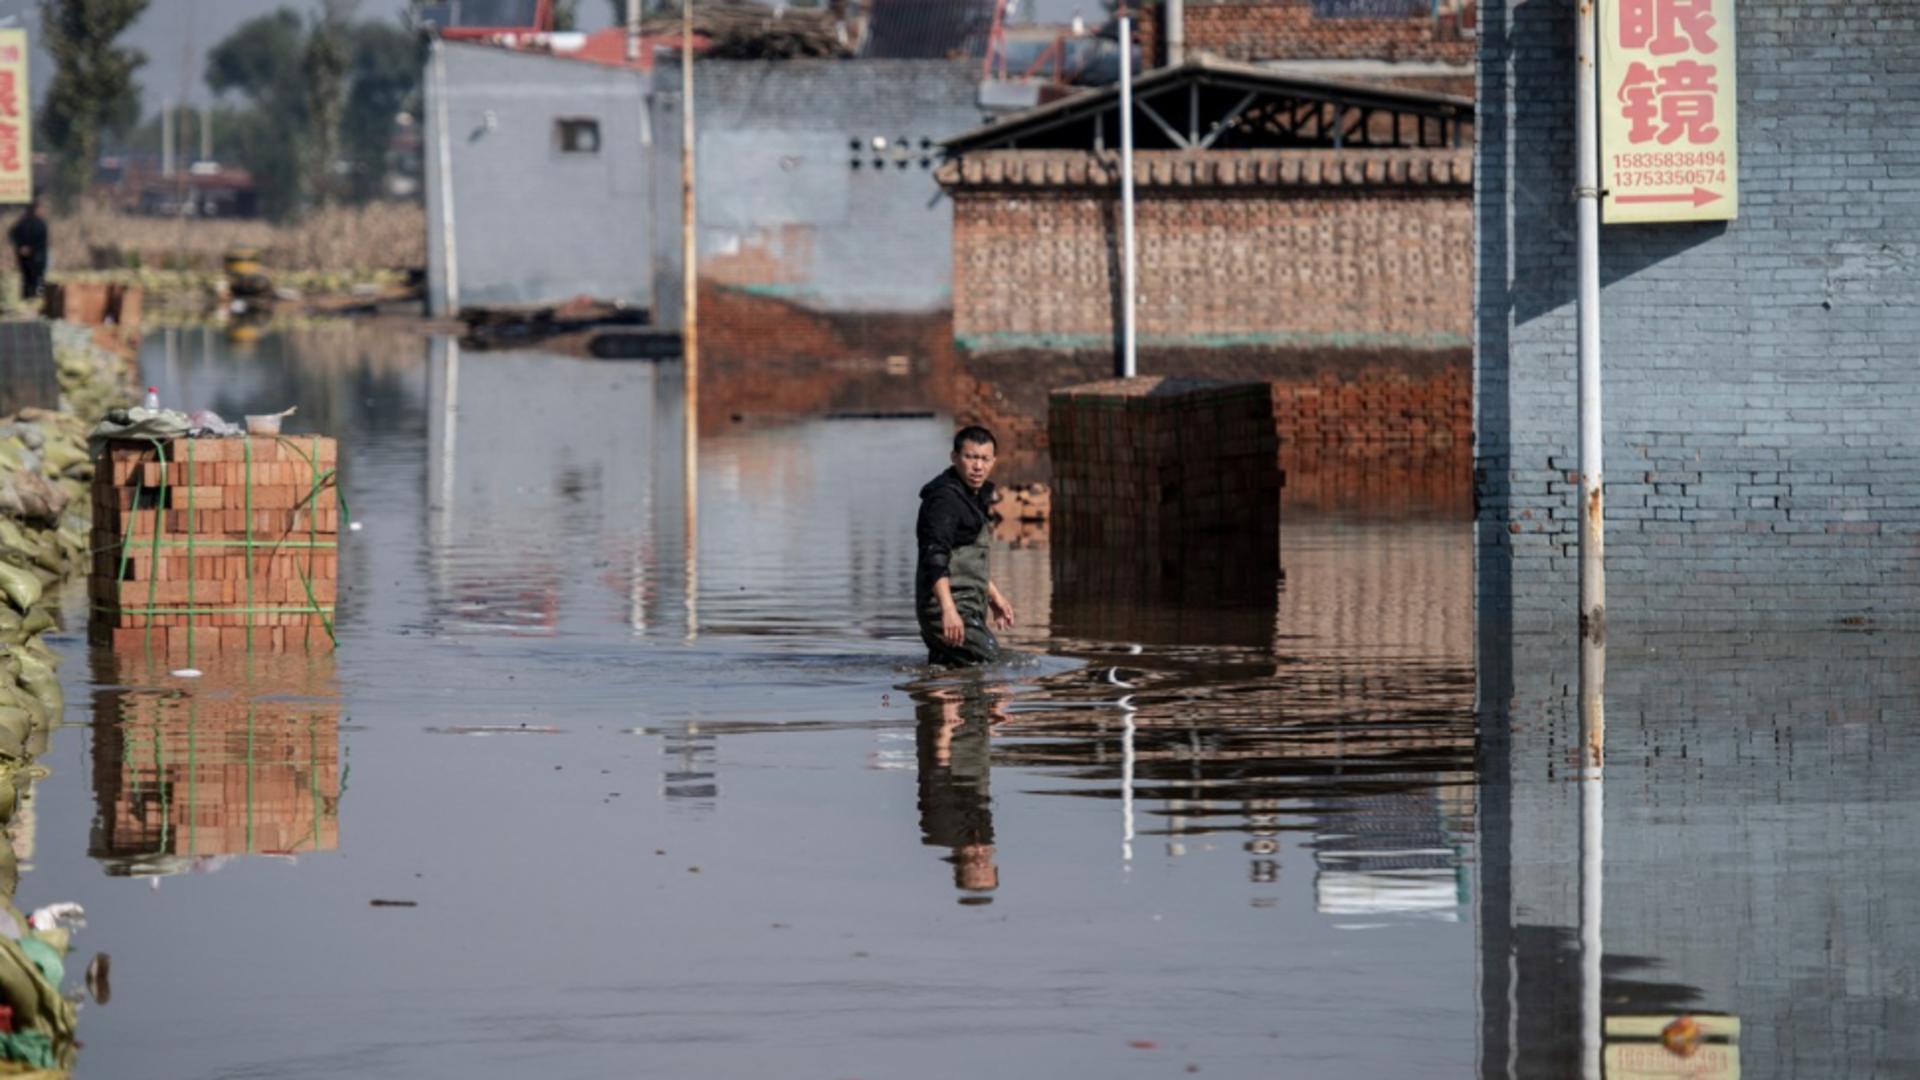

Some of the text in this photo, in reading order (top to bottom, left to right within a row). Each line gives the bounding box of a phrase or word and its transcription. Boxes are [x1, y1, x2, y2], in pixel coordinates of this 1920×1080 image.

[1618, 0, 1719, 144] 眼镜
[1613, 151, 1726, 168] 15835838494
[1613, 169, 1726, 187] 13753350574
